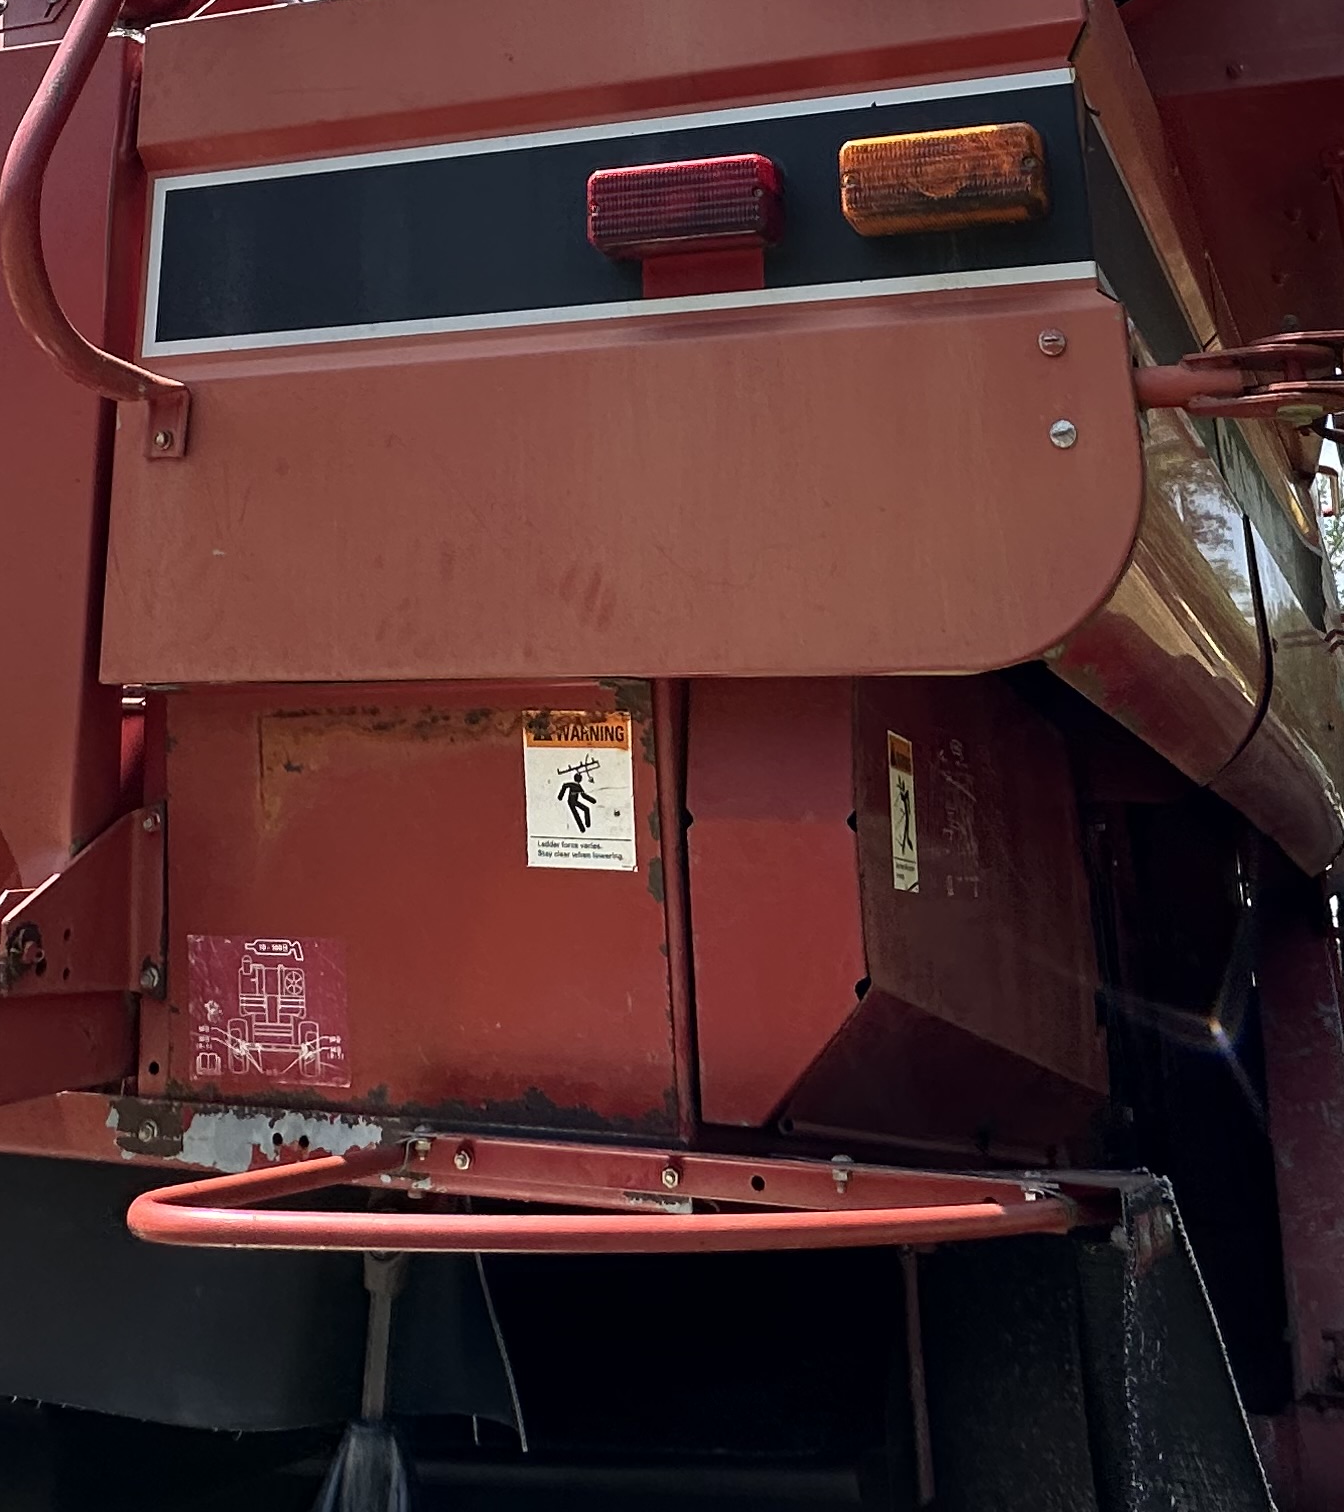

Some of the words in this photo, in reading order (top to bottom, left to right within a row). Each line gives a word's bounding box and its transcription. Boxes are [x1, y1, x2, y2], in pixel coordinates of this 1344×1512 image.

[557, 725, 625, 742] WARNING
[537, 840, 560, 848] Ladder
[537, 849, 553, 858] Stay
[554, 850, 570, 858] clear
[572, 851, 591, 859] when
